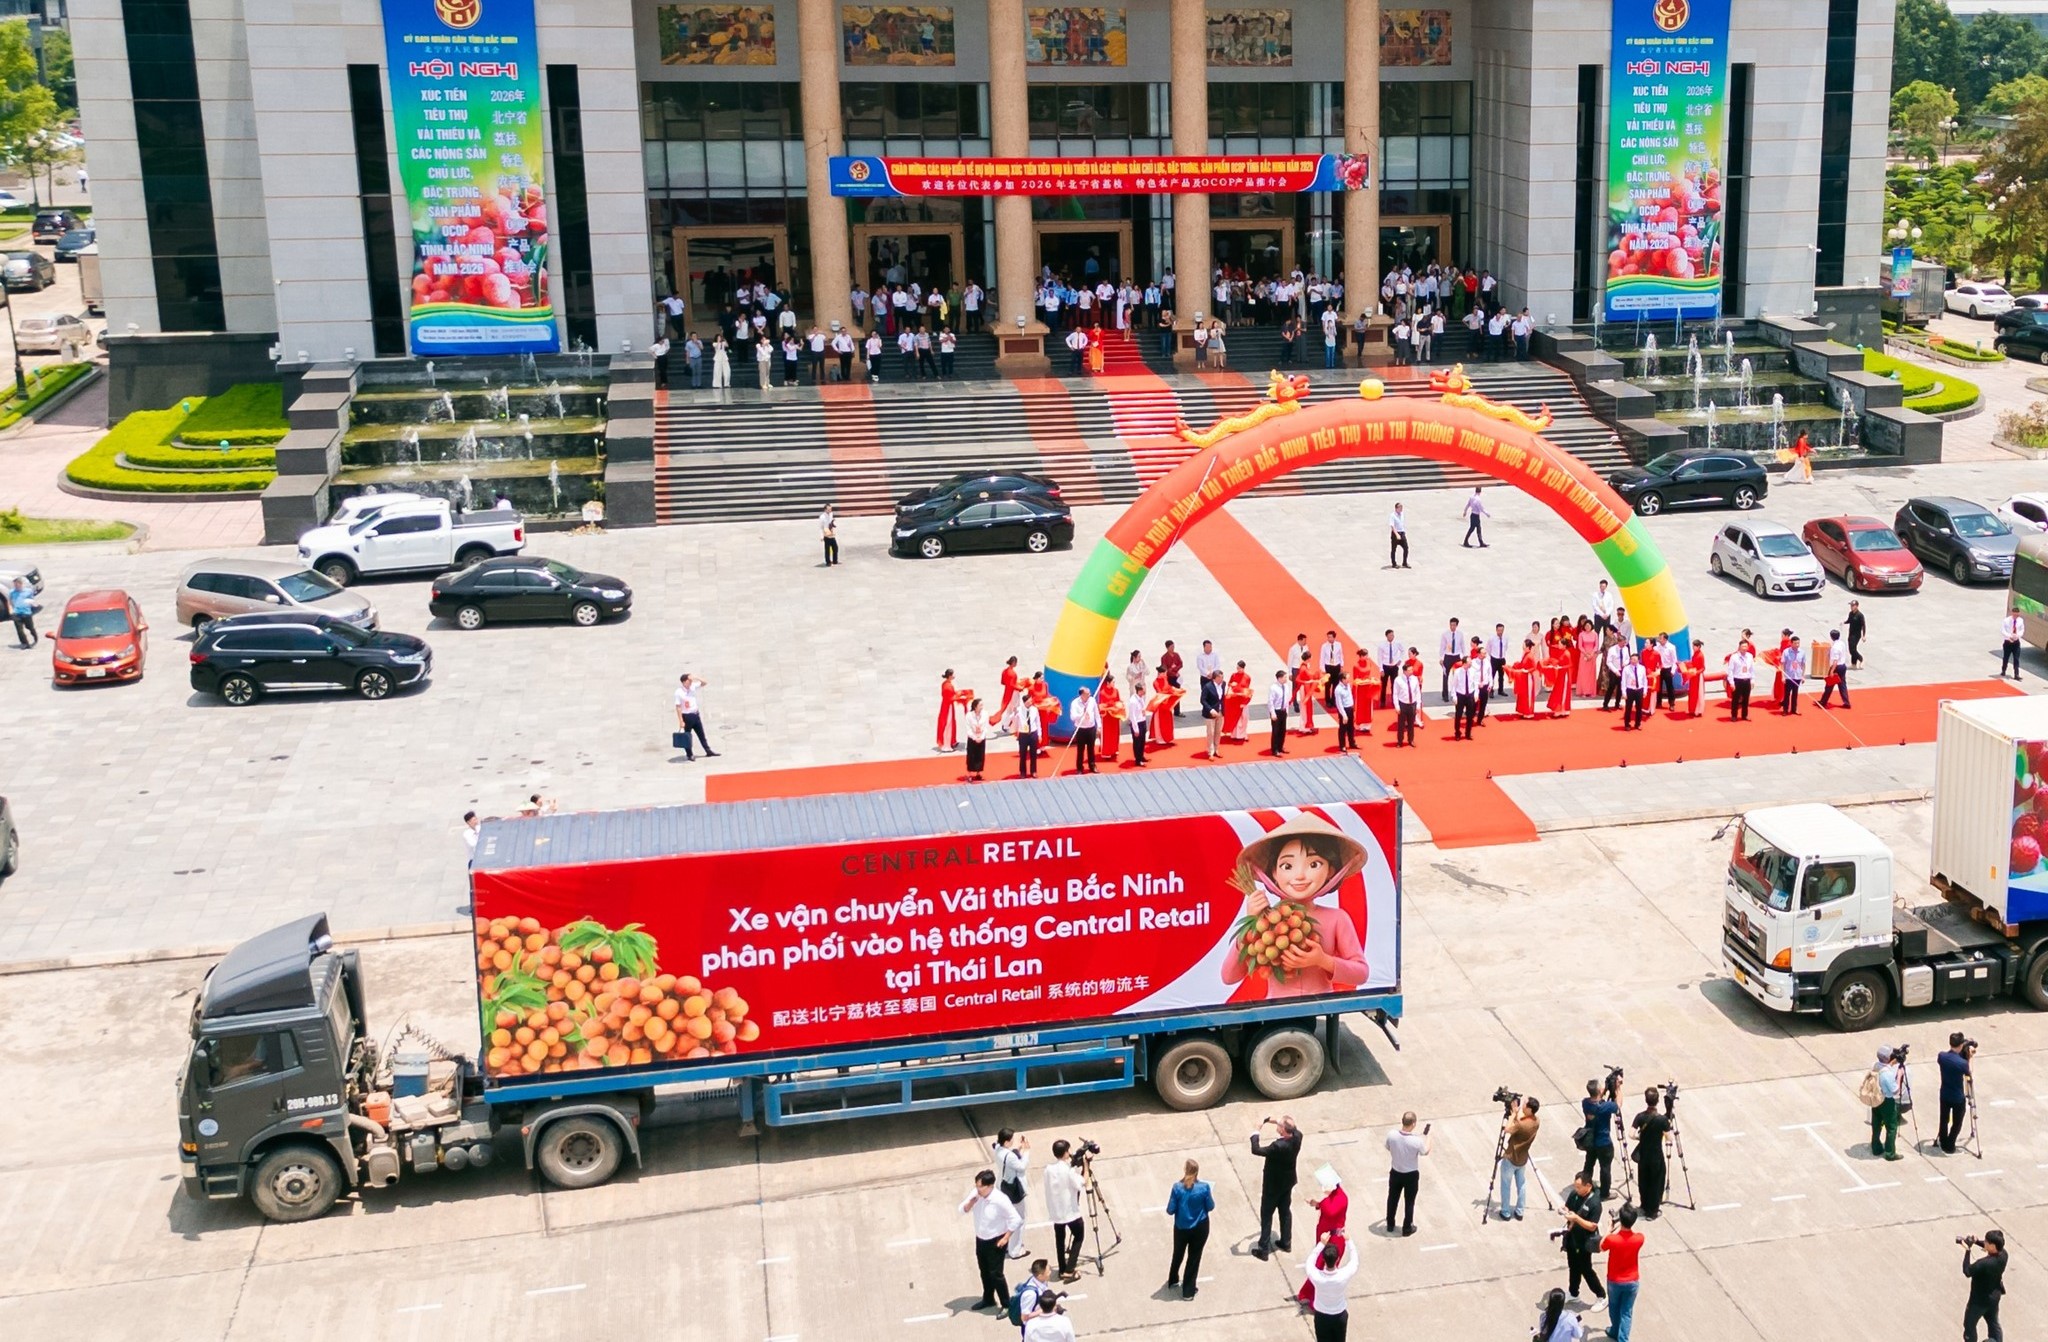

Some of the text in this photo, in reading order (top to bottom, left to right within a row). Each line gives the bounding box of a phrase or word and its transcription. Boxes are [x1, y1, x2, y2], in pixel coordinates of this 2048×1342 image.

[409, 59, 518, 80] HỘI NGHỊ
[1627, 58, 1709, 77] HỘI NGHỊ
[444, 87, 467, 101] TIẾN
[490, 89, 525, 102] 2026年
[1686, 84, 1713, 96] 2026年
[448, 109, 468, 123] THỤ
[1653, 103, 1667, 115] THỤ
[492, 111, 527, 125] 北宁省
[1021, 180, 1052, 189] 2026
[1640, 206, 1660, 216] OCOP
[442, 225, 469, 237] OCOP
[469, 244, 494, 256] NINH
[461, 263, 484, 274] 2026
[1280, 435, 1309, 460] NINH
[1339, 424, 1360, 446] THỤ
[1366, 422, 1384, 444] TẠI
[1389, 421, 1407, 442] THỊ
[1458, 429, 1495, 457] TRONG
[729, 871, 1184, 933] Xe vận chuyển Vải thiều Bắc Ninh
[702, 902, 1210, 977] phân phối vào hệ thống Central Retail
[885, 956, 1042, 993] tại Thái Lan
[773, 975, 1150, 1027] 配送北宁荔枝至泰国 Central Retail 系统的物流车
